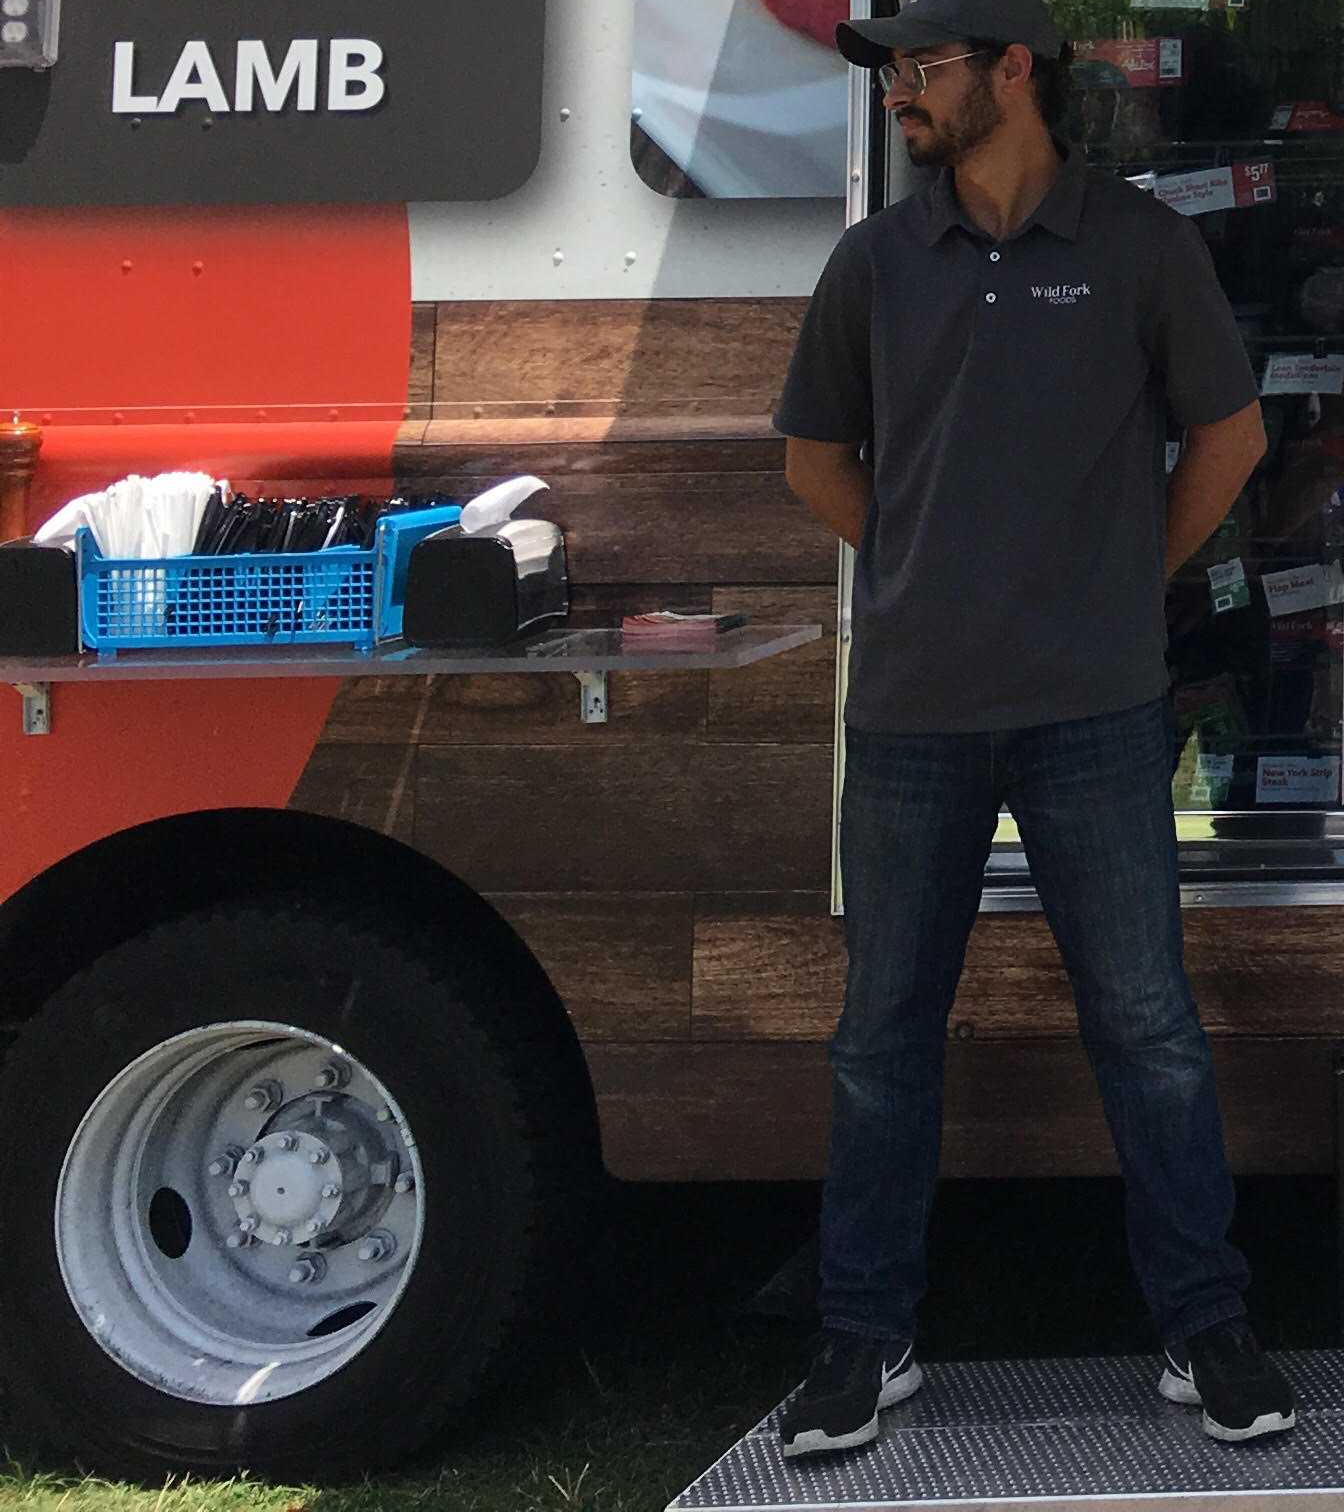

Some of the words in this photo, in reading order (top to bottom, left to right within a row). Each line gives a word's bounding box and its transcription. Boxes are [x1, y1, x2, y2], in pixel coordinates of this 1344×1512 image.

[112, 37, 386, 113] LAMB
[1031, 286, 1060, 298] Wild
[1063, 283, 1091, 297] Fork
